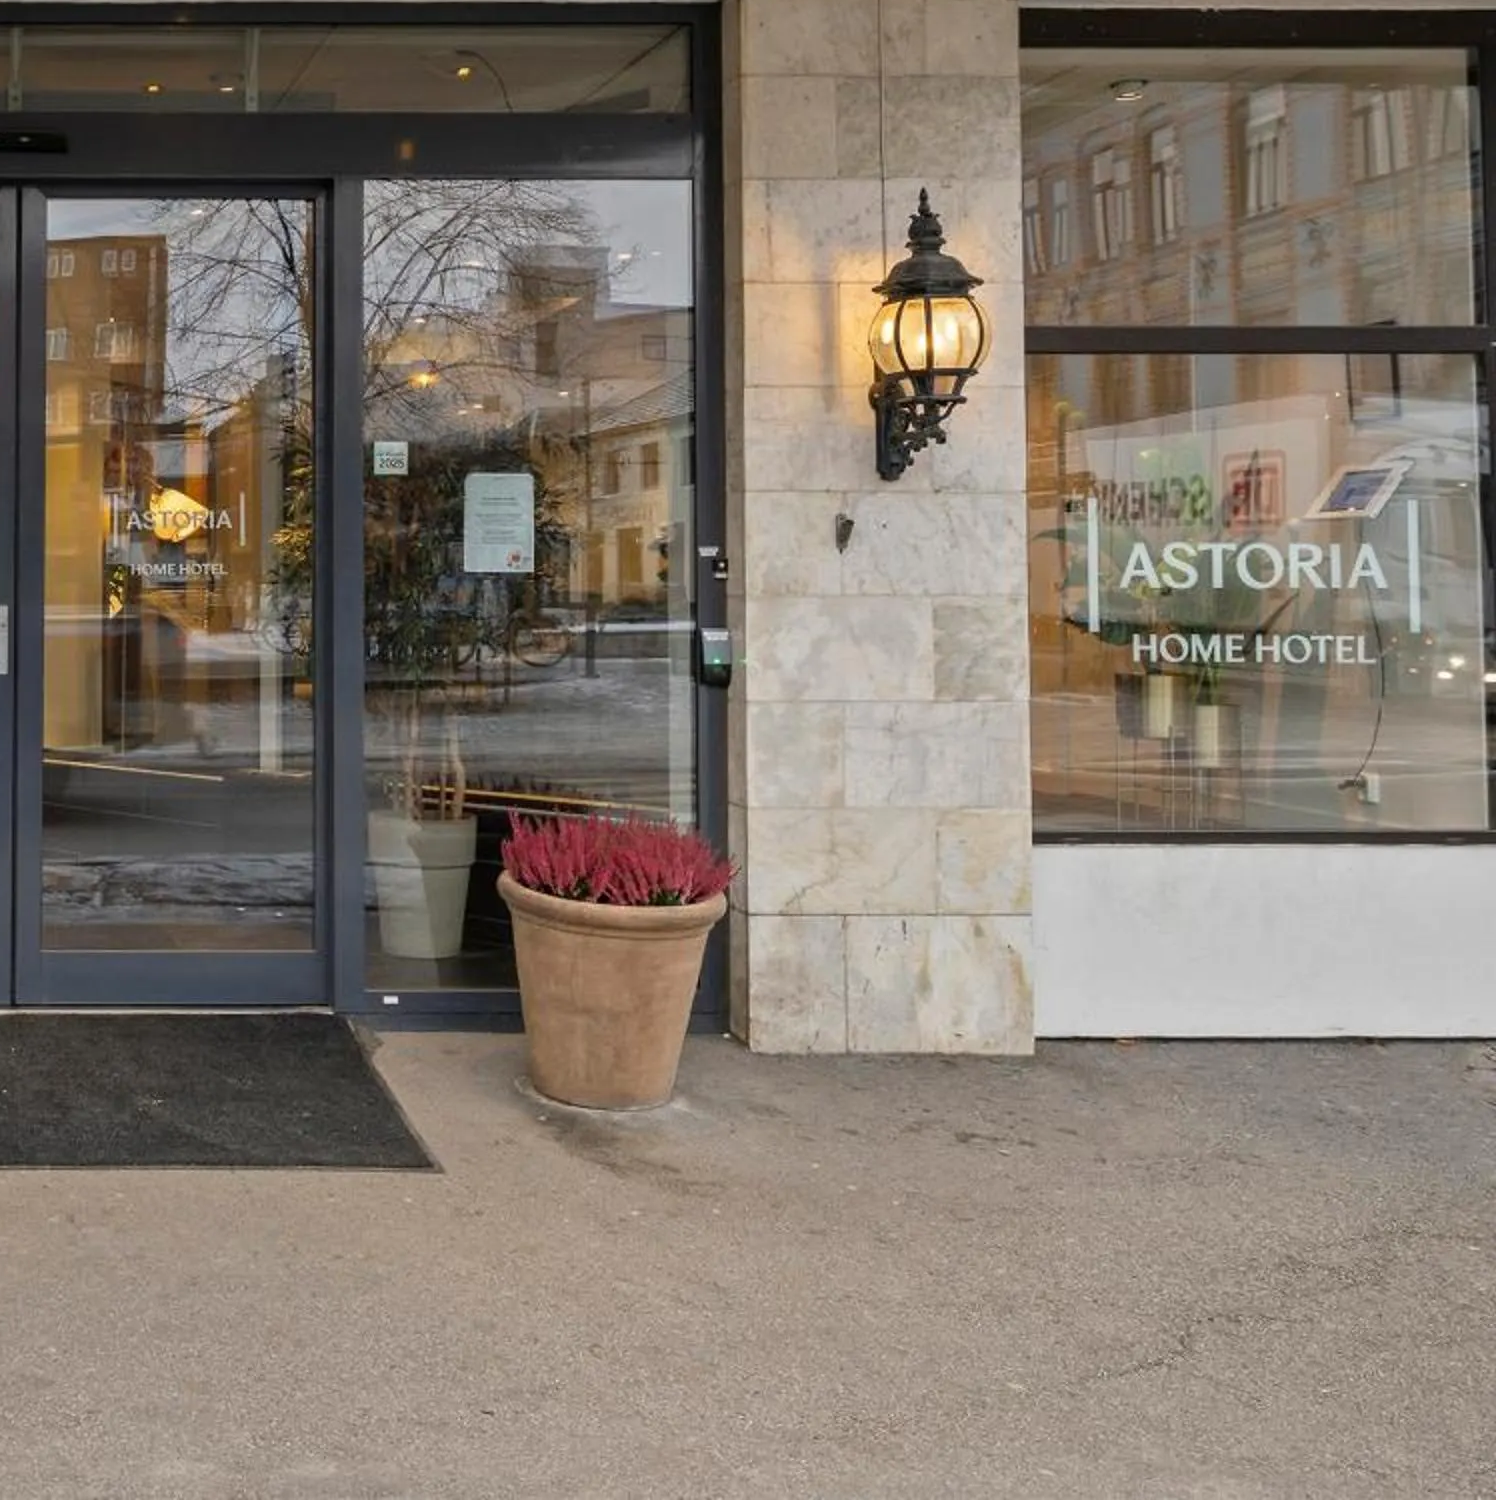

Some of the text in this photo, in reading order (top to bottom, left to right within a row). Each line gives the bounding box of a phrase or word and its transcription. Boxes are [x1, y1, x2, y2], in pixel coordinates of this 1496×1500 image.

[126, 509, 233, 530] ASTORIA
[131, 563, 228, 576] HOME HOTEL
[1120, 542, 1389, 590] ASTORIA
[1132, 634, 1377, 664] HOME HOTEL
